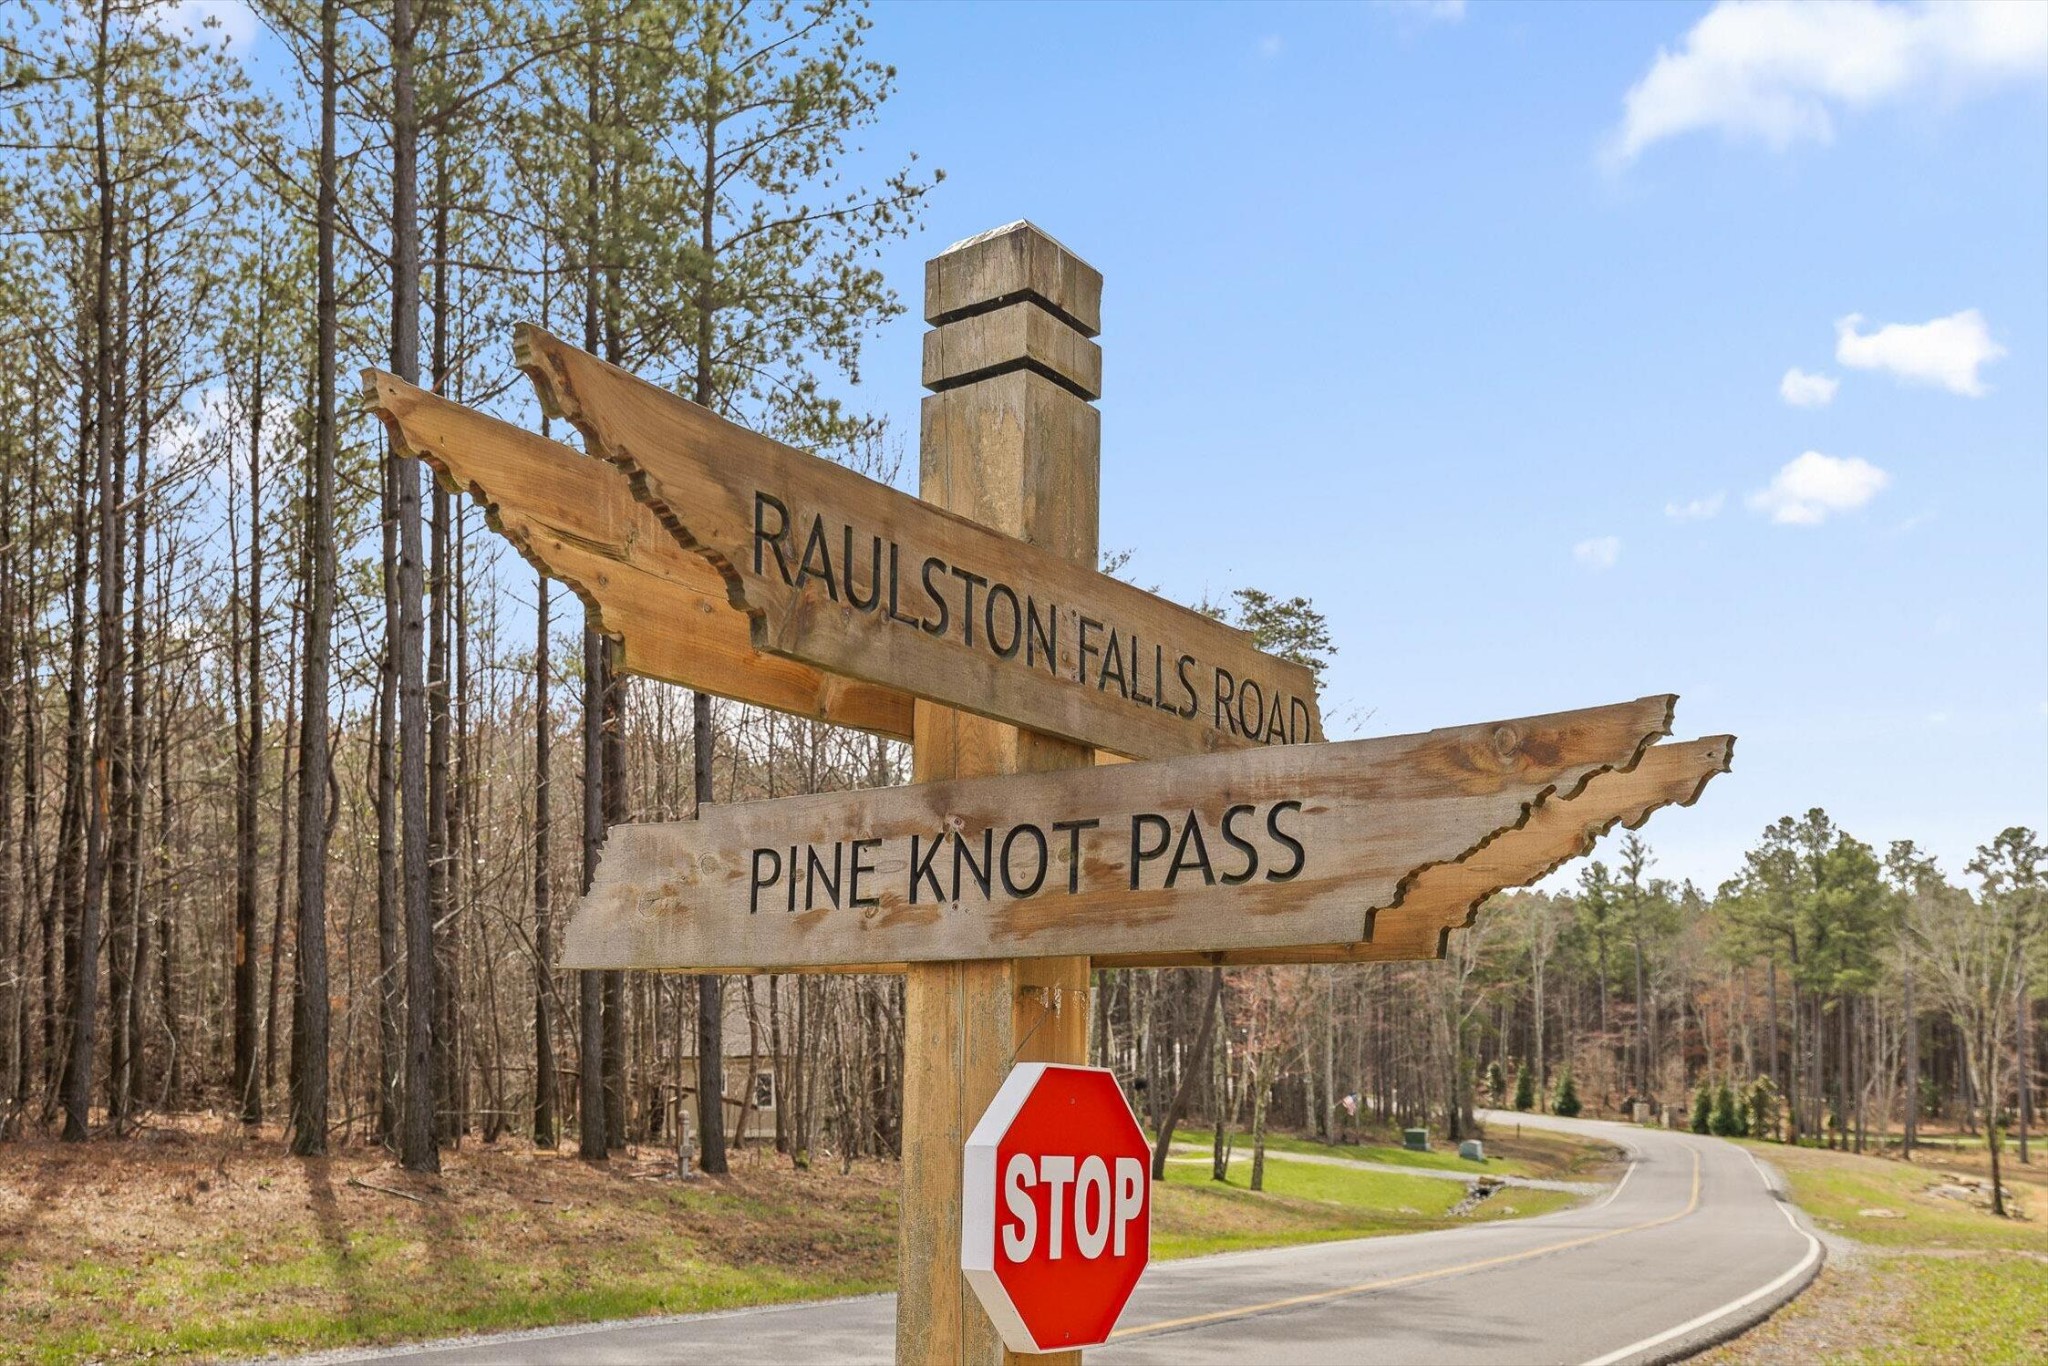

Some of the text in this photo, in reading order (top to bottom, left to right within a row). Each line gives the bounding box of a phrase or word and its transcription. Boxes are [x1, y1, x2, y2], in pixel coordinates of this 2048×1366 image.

[754, 491, 1310, 744] RAULSTON FALLS ROAD
[750, 800, 1305, 914] PINE KNOT PASS
[1002, 1153, 1144, 1263] STOP
